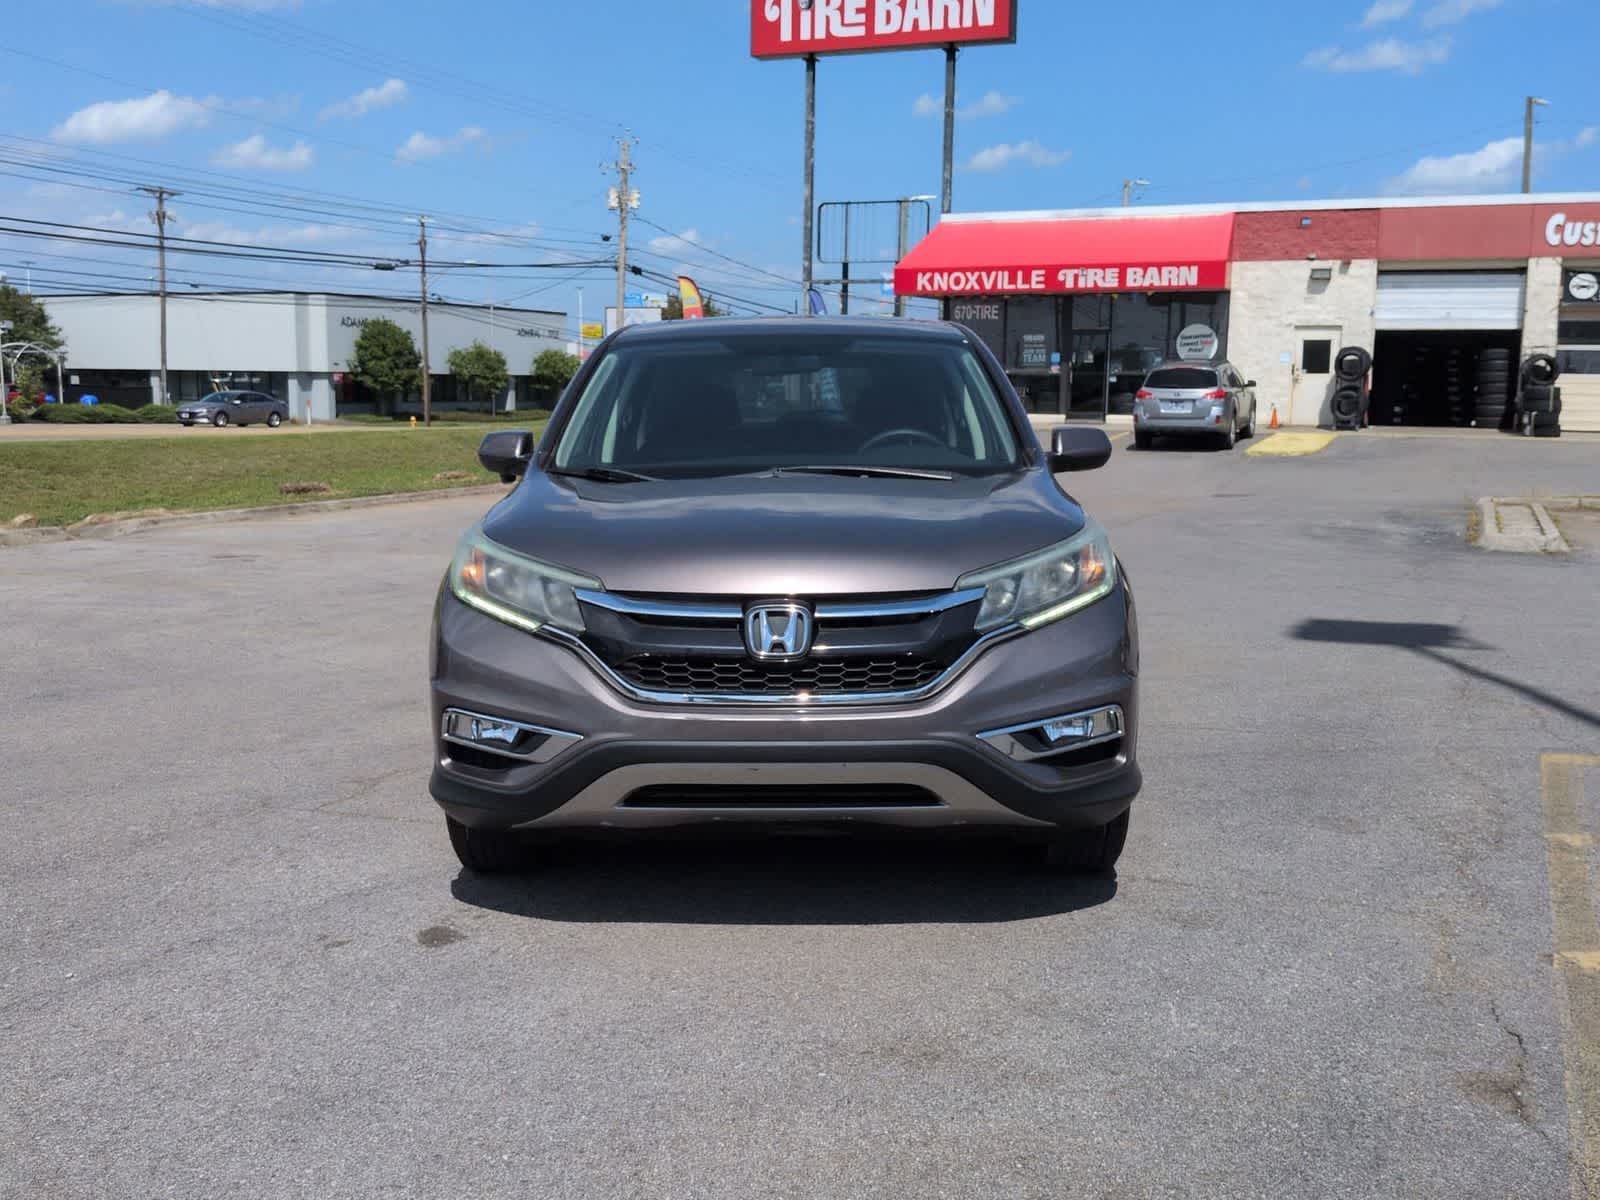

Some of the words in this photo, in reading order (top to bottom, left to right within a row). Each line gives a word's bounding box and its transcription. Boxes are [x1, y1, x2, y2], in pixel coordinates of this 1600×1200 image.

[874, 0, 995, 35] BARN
[916, 269, 1046, 292] KNOXVILLE
[1126, 265, 1199, 287] BARN
[954, 304, 999, 321] 670-TIRE
